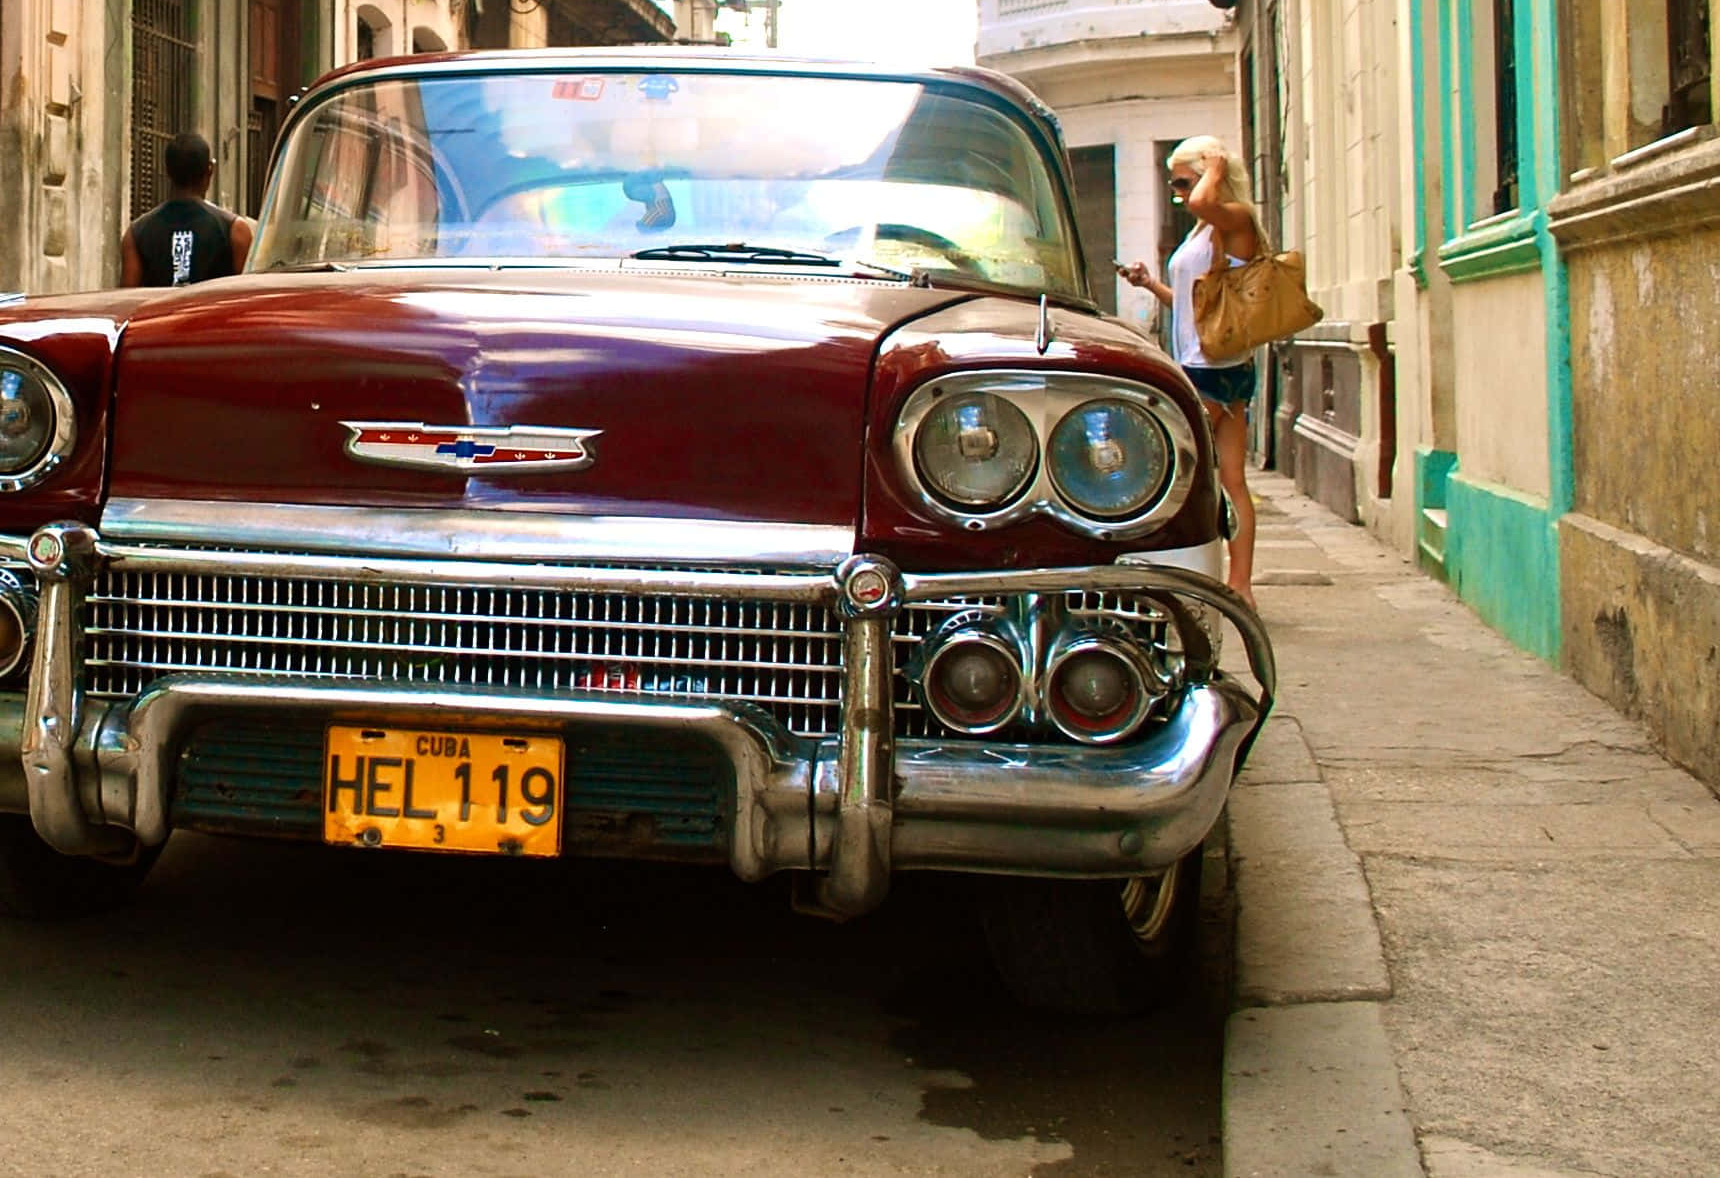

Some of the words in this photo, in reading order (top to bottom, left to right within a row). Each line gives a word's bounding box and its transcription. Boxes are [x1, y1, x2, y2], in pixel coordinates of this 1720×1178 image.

[416, 735, 471, 758] CUBA
[329, 754, 437, 820] HEL
[455, 762, 555, 826] 119
[433, 824, 445, 844] 3
